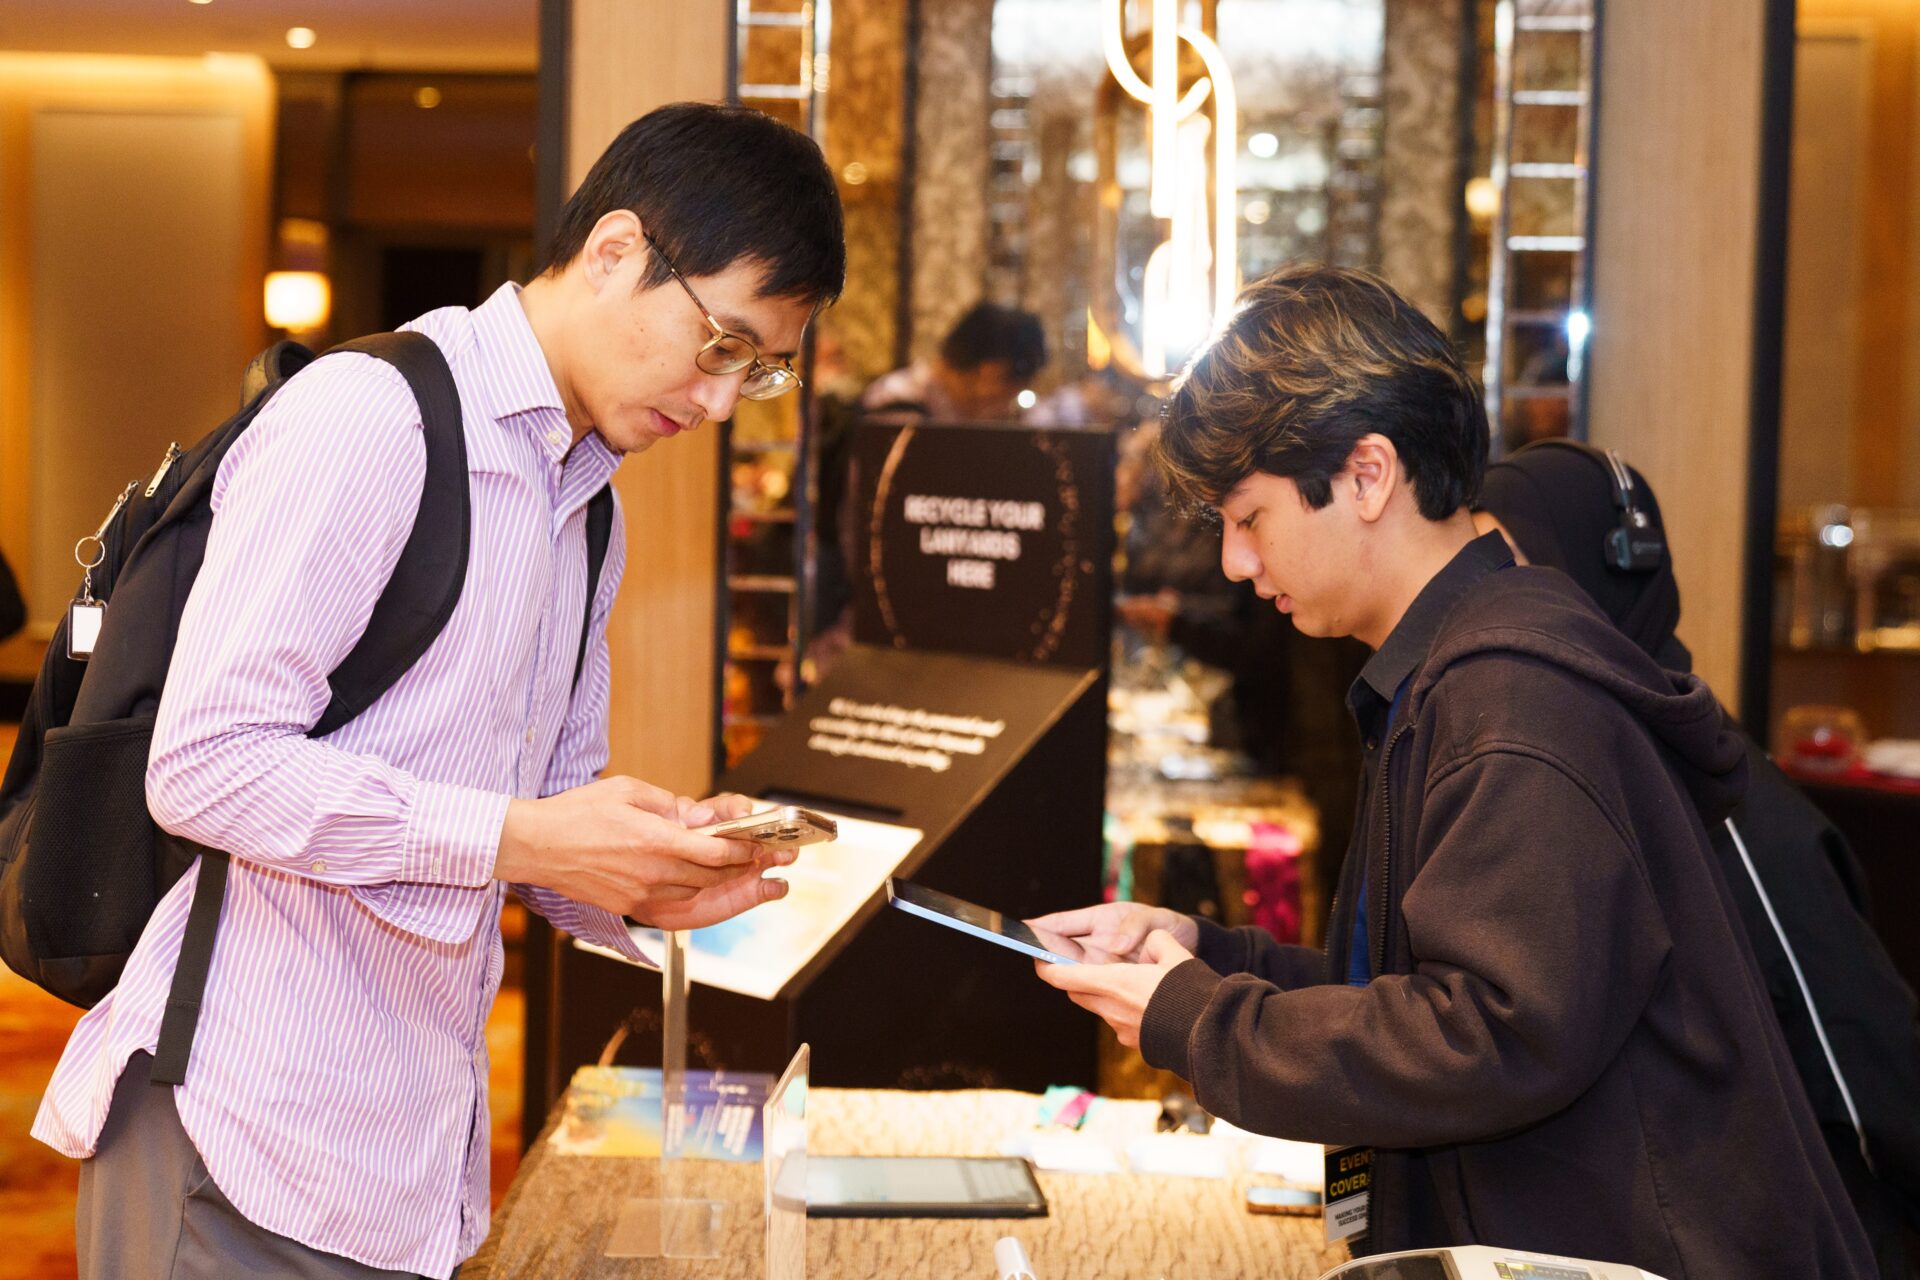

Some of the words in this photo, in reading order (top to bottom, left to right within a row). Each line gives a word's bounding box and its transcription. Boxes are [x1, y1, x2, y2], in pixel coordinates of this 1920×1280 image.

[904, 495, 988, 526] RECYCLE
[990, 500, 1044, 529] YOUR
[920, 527, 1020, 560] LANYARDS
[947, 559, 995, 589] HERE
